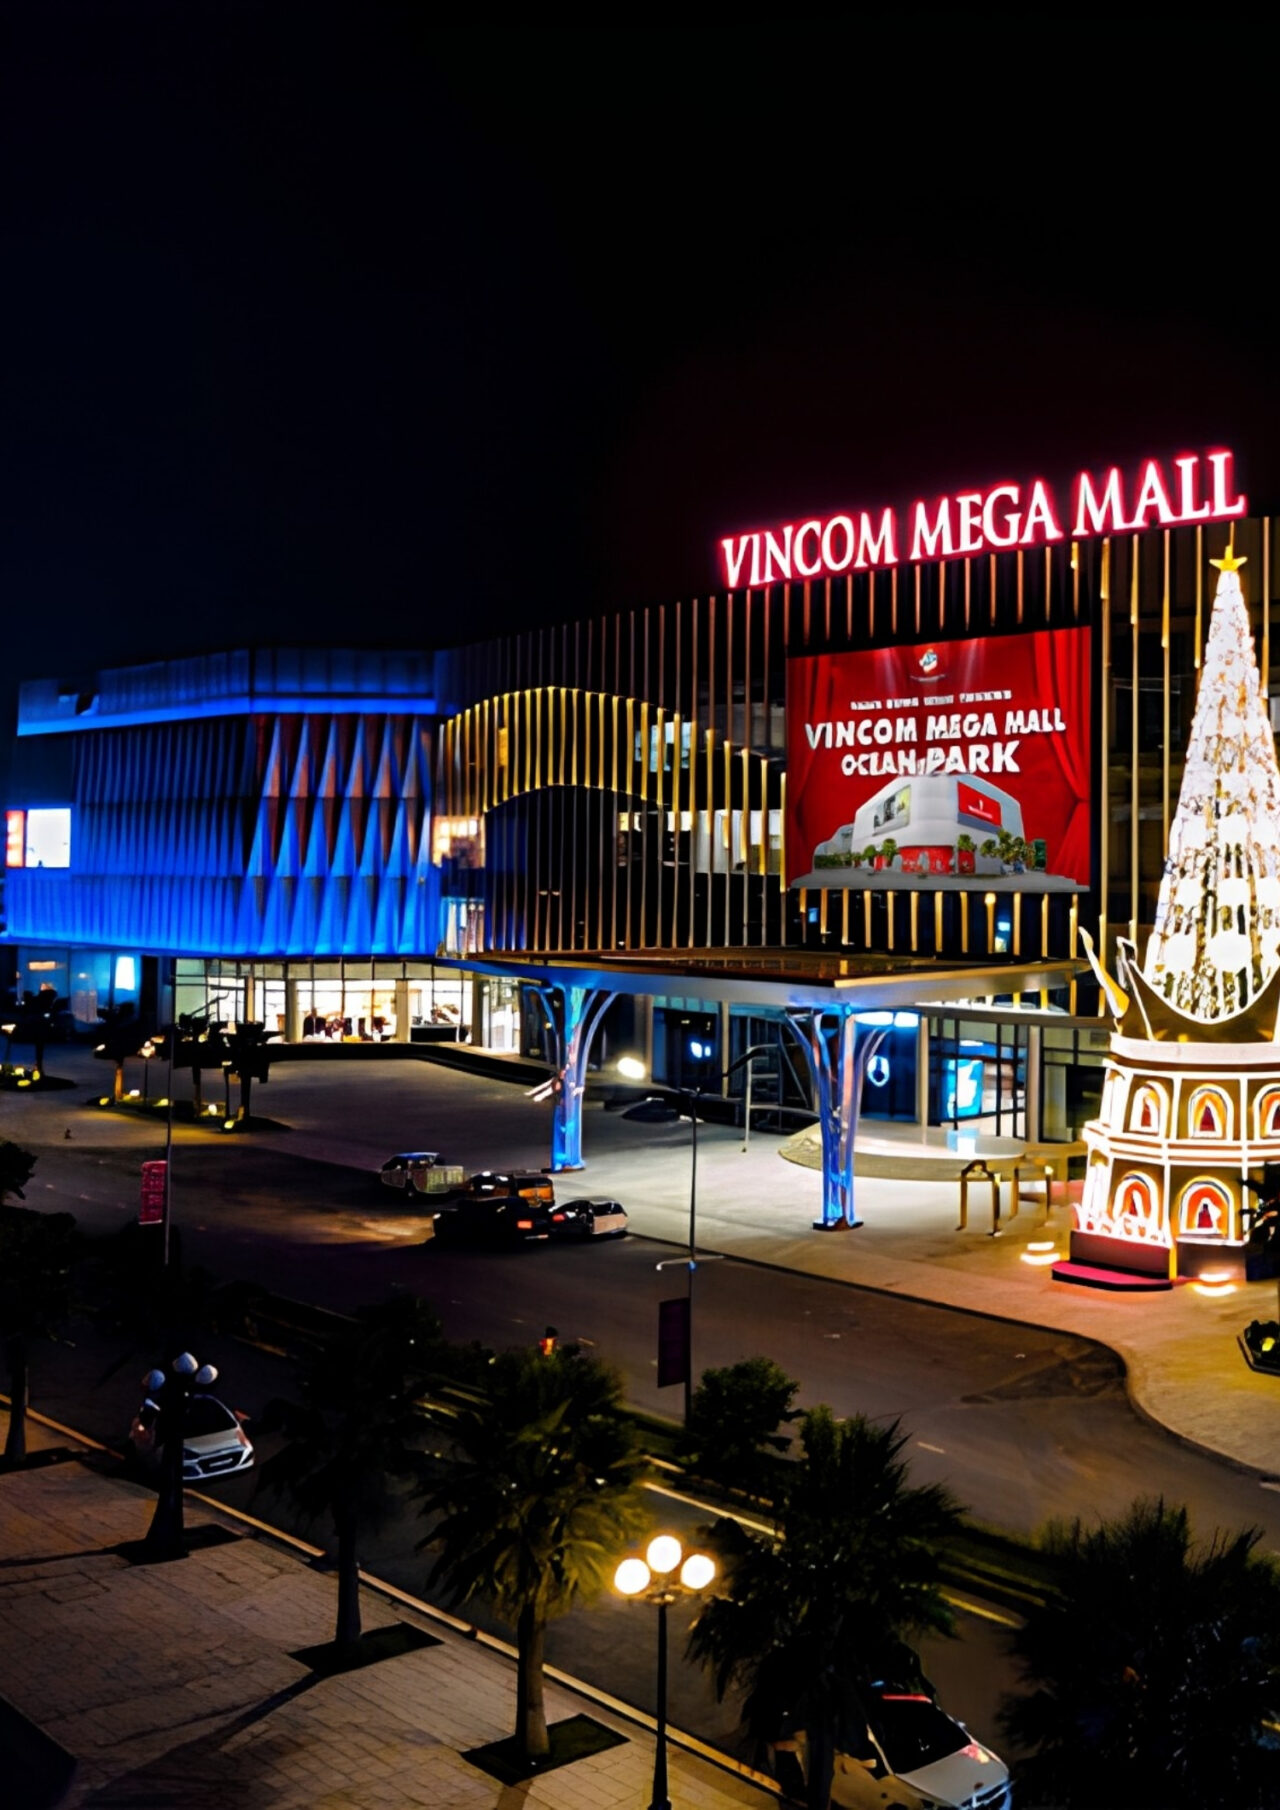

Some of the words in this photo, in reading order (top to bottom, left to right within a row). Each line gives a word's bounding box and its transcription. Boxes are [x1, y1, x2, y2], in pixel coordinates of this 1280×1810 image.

[721, 507, 897, 588] VINCOM
[910, 481, 1062, 560] MEGA
[1072, 451, 1246, 536] MALL
[804, 717, 918, 750] VINCOM
[925, 712, 997, 741] MEGA
[1005, 707, 1066, 735] MALL
[841, 749, 918, 776] OCEAN
[925, 740, 1020, 775] PARK
